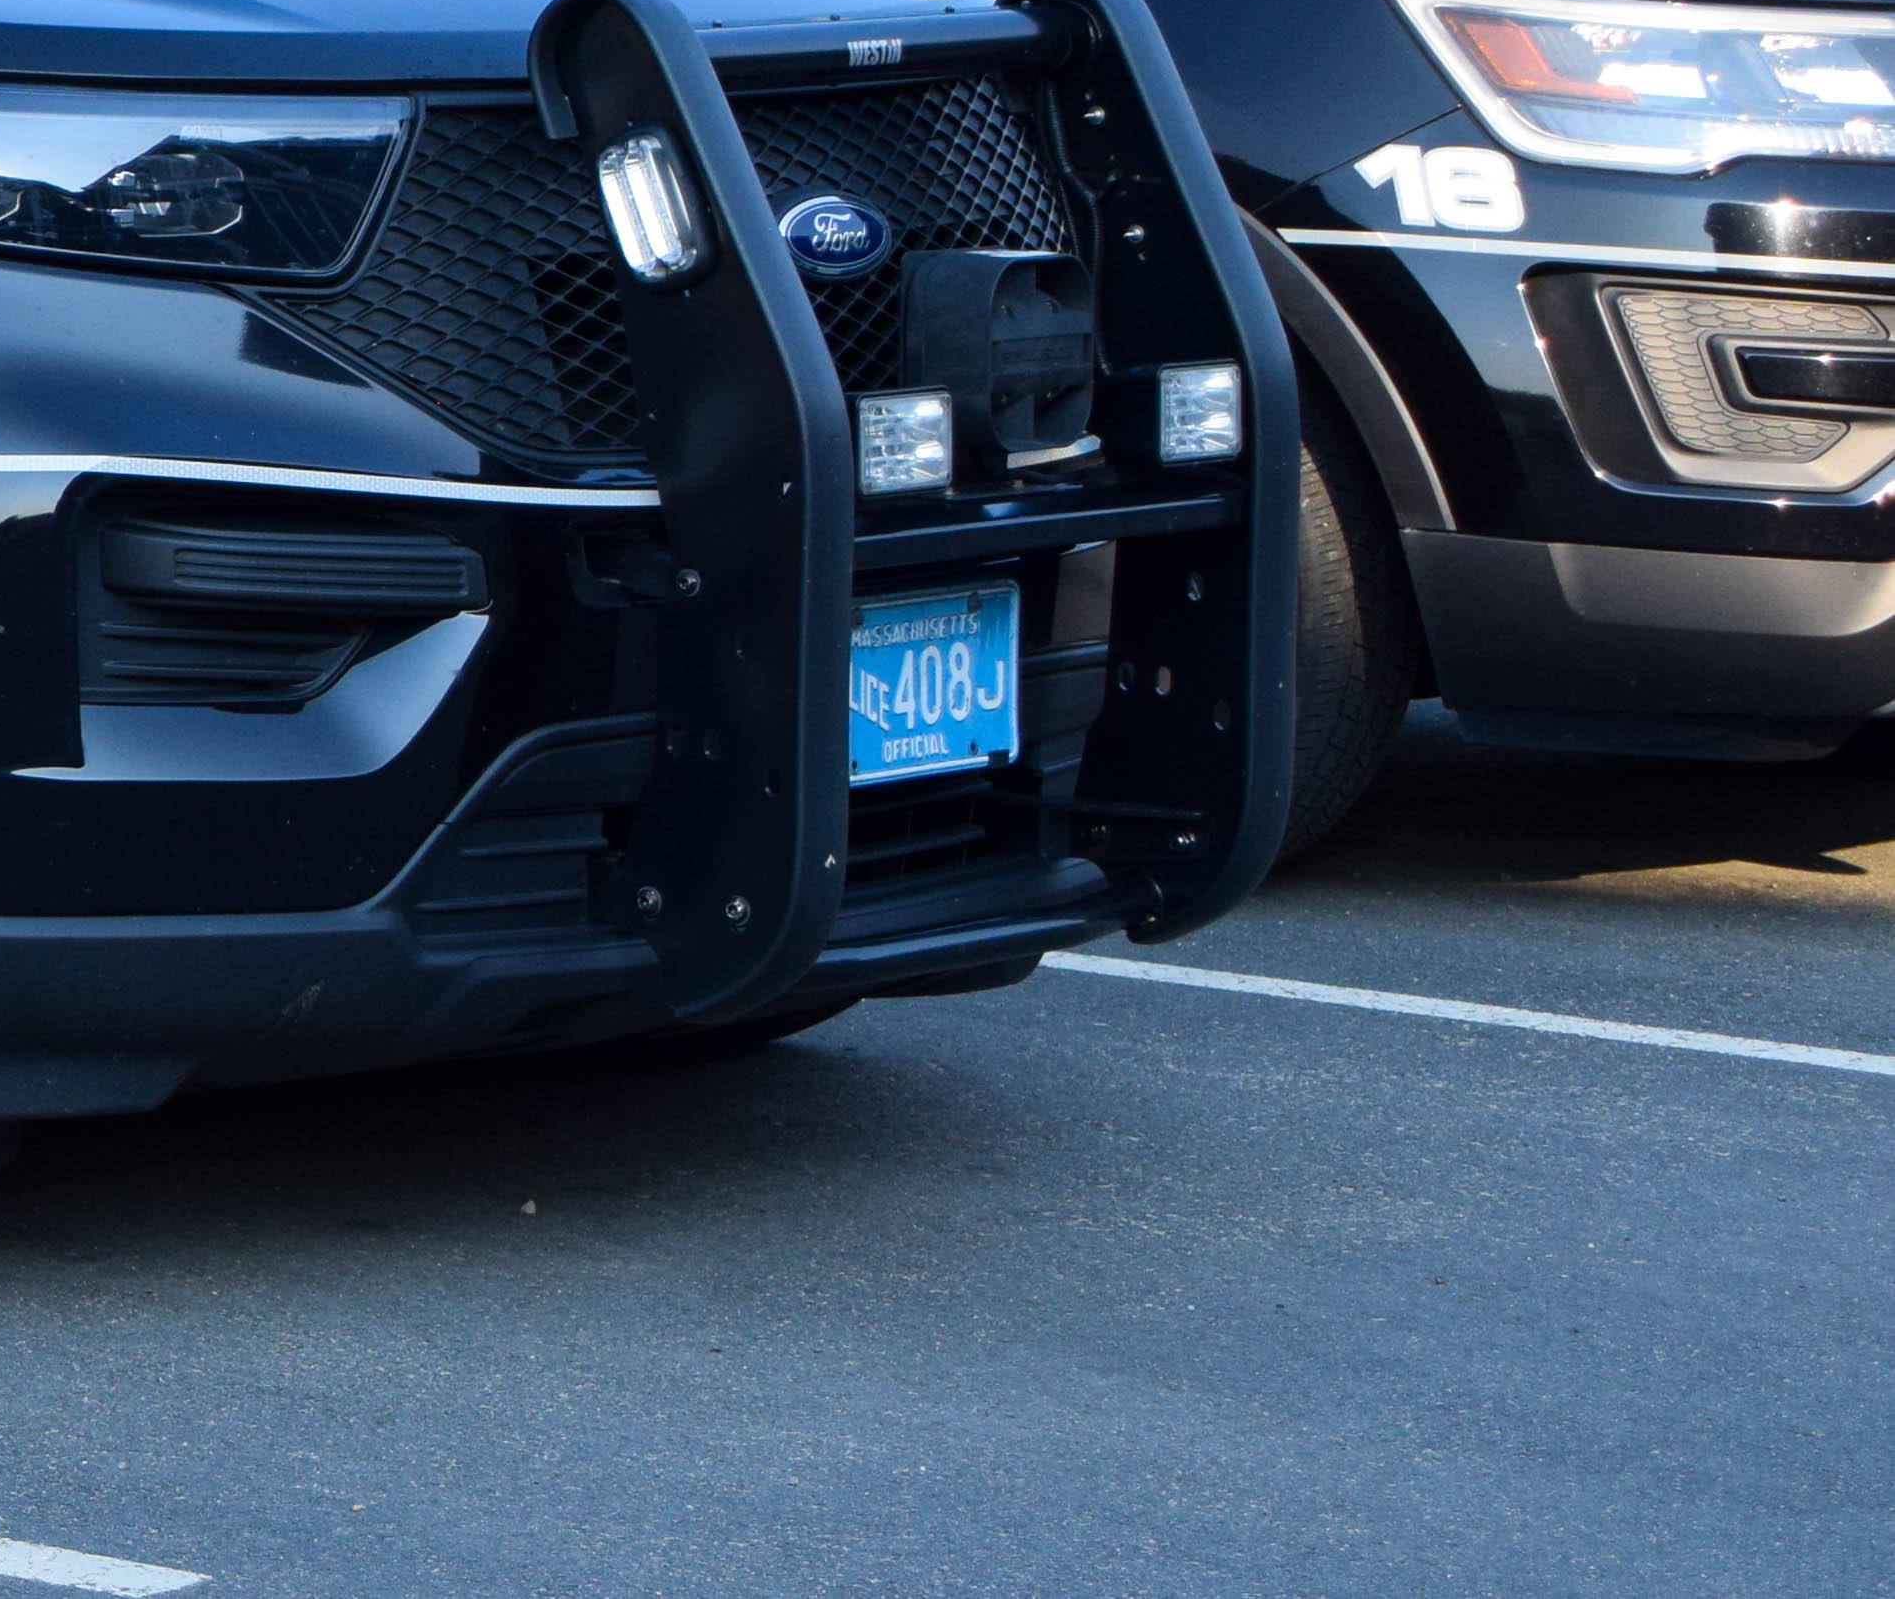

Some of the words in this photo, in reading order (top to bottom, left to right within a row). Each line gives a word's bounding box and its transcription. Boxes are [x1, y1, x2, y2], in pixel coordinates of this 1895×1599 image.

[812, 213, 870, 252] Ford
[850, 613, 979, 647] MASSACHUSETTS
[849, 661, 890, 731] LICE
[884, 733, 949, 763] OFFICIAL
